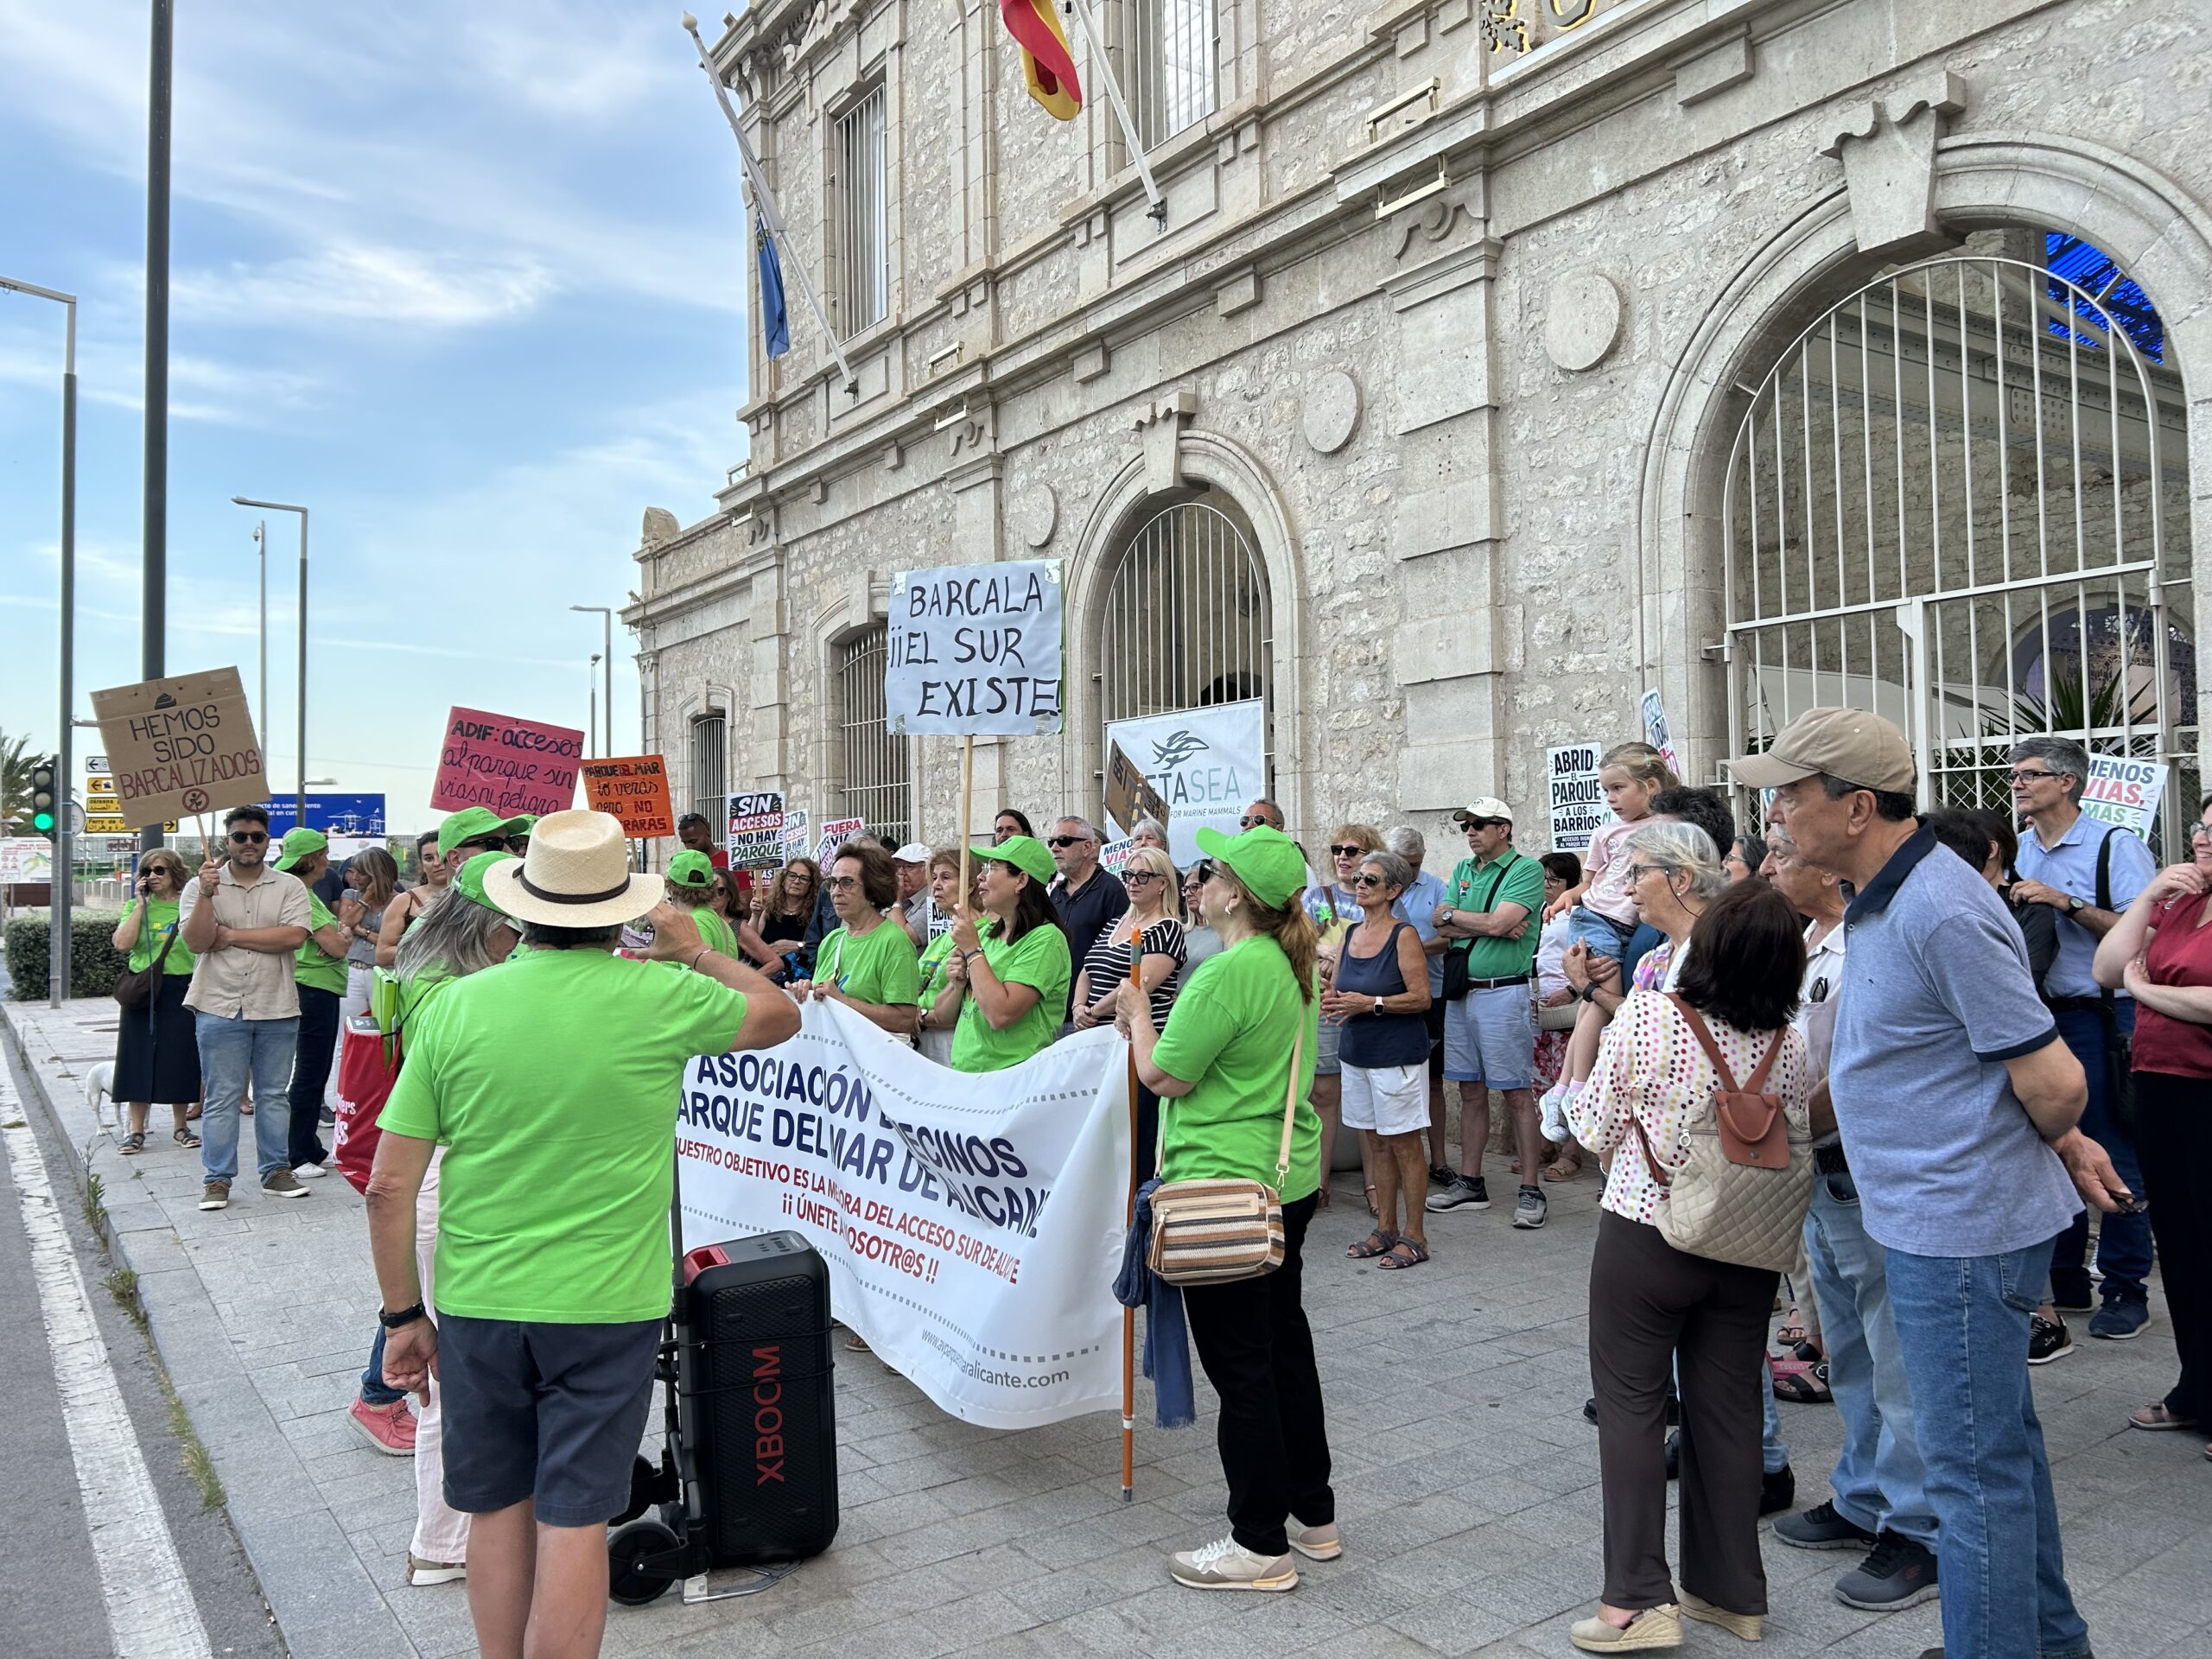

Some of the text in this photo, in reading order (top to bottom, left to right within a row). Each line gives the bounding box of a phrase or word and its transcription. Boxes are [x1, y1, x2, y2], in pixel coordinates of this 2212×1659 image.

[910, 572, 1043, 618] BARCALA
[954, 627, 1026, 669] SUR
[129, 704, 220, 741] HEMOS
[501, 728, 582, 759] accesos
[119, 748, 260, 800] BARCALIZADOS
[442, 741, 573, 790] al parque sin
[634, 761, 660, 775] MAR
[1554, 749, 1594, 776] ABRID
[1571, 772, 1578, 781] EL
[1552, 779, 1601, 804] PARQUE
[633, 800, 653, 813] NO
[738, 795, 772, 817] SIN
[1183, 809, 1206, 817] MARINE
[1208, 805, 1241, 816] MAMMALS
[1566, 805, 1587, 817] A LOS
[731, 813, 782, 832] ACCESOS
[823, 819, 861, 834] FUERA
[1554, 815, 1601, 832] BARRIOS
[738, 830, 778, 845] NO HAY
[1104, 839, 1134, 855] MENO
[731, 842, 784, 862] PARQUE
[697, 1052, 872, 1122] ASOCIACIÓN
[677, 1088, 764, 1142] ARQUE
[772, 1109, 828, 1158] DEL
[676, 1137, 722, 1166] UESTRO
[724, 1151, 790, 1183] OBJETIVO
[793, 1167, 809, 1189] ES
[811, 1172, 826, 1195] LA
[828, 1179, 861, 1217] MEORA
[864, 1200, 893, 1229] DEL
[895, 1212, 956, 1251] ACCESO
[956, 1234, 982, 1264] SUR
[981, 1244, 998, 1270] DE
[797, 1193, 837, 1234] ÚNETE
[843, 1220, 925, 1278] OSOTR@S
[926, 1257, 940, 1284] !!
